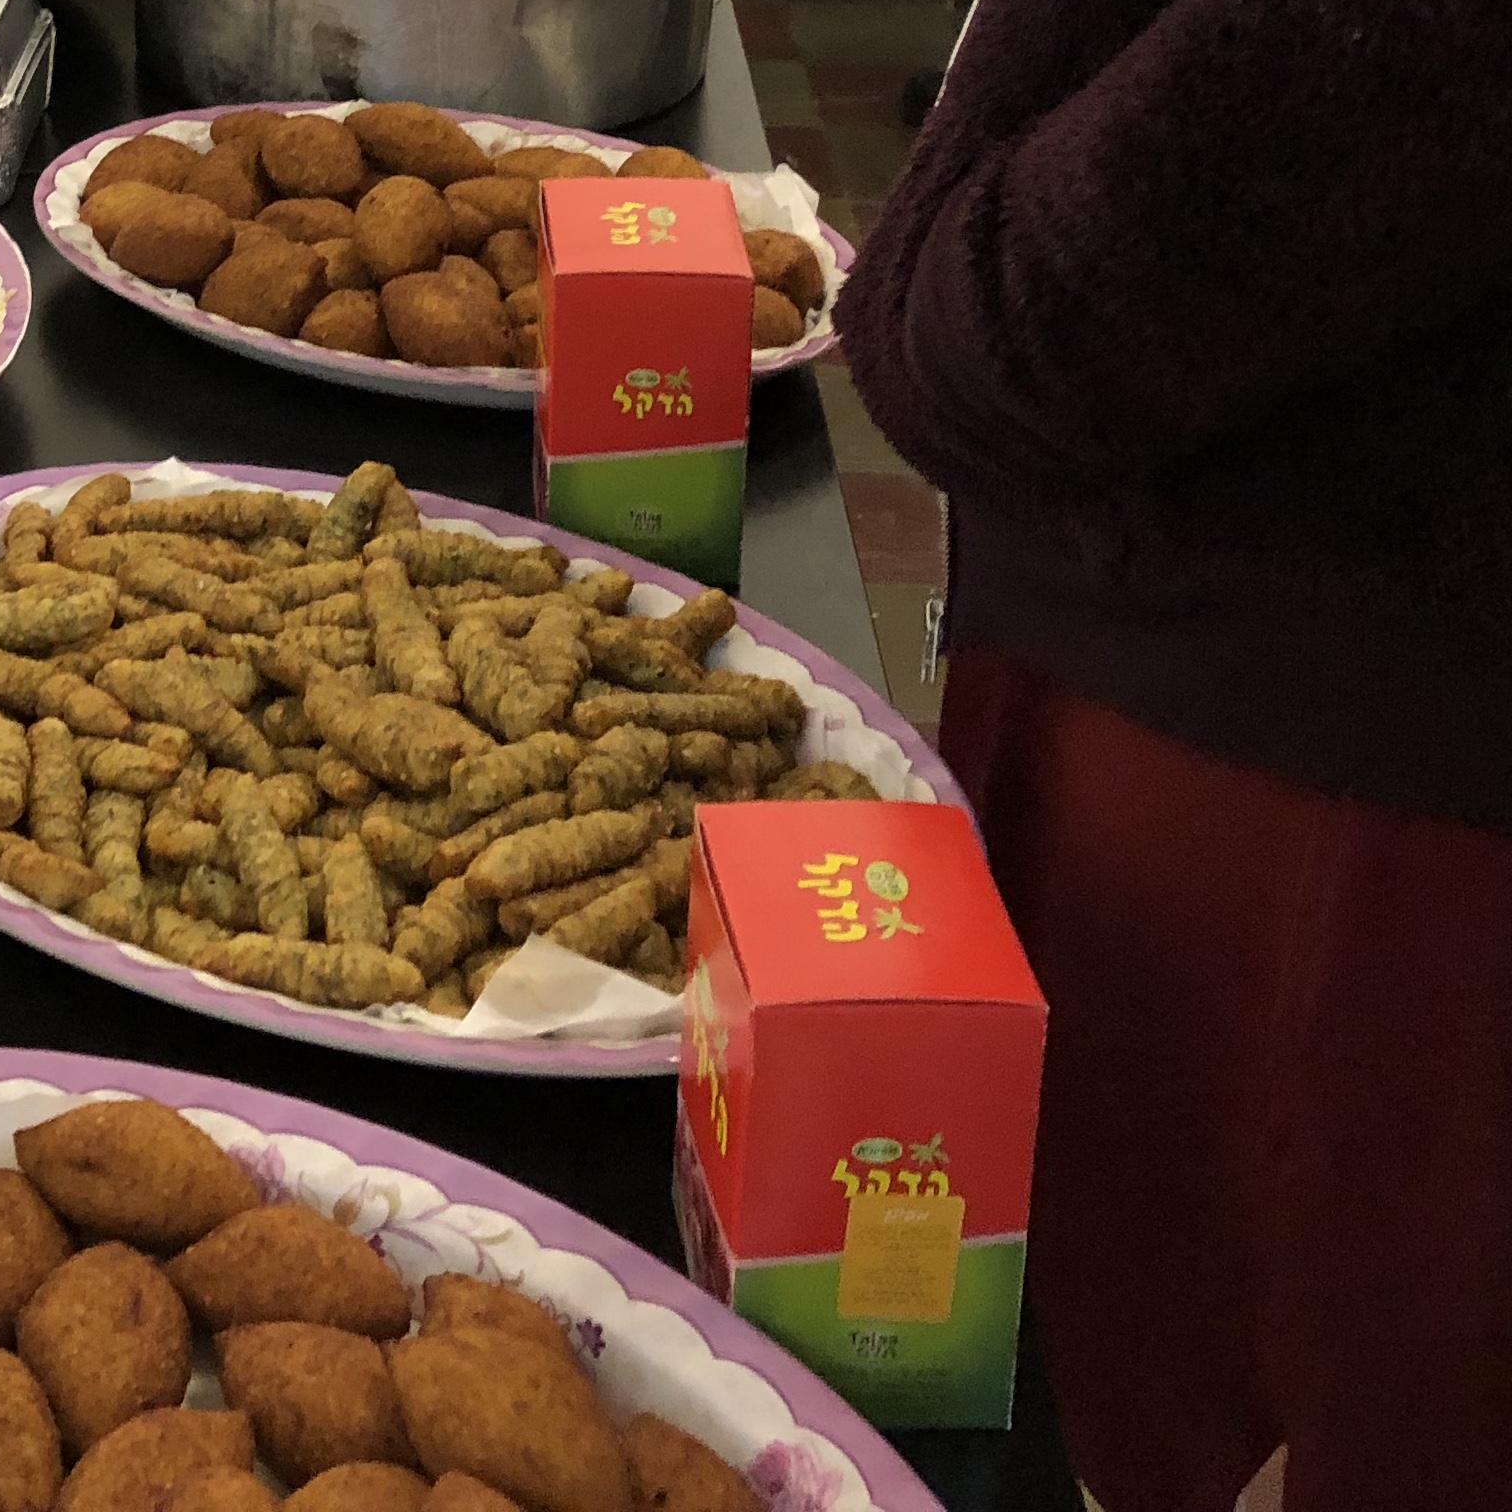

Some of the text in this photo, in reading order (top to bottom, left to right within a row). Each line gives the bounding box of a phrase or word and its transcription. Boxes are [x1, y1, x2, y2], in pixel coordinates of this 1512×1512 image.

[600, 201, 647, 245] הדקל
[612, 384, 693, 419] הדקל
[797, 852, 867, 942] הדקל
[831, 1158, 949, 1199] הדקל
